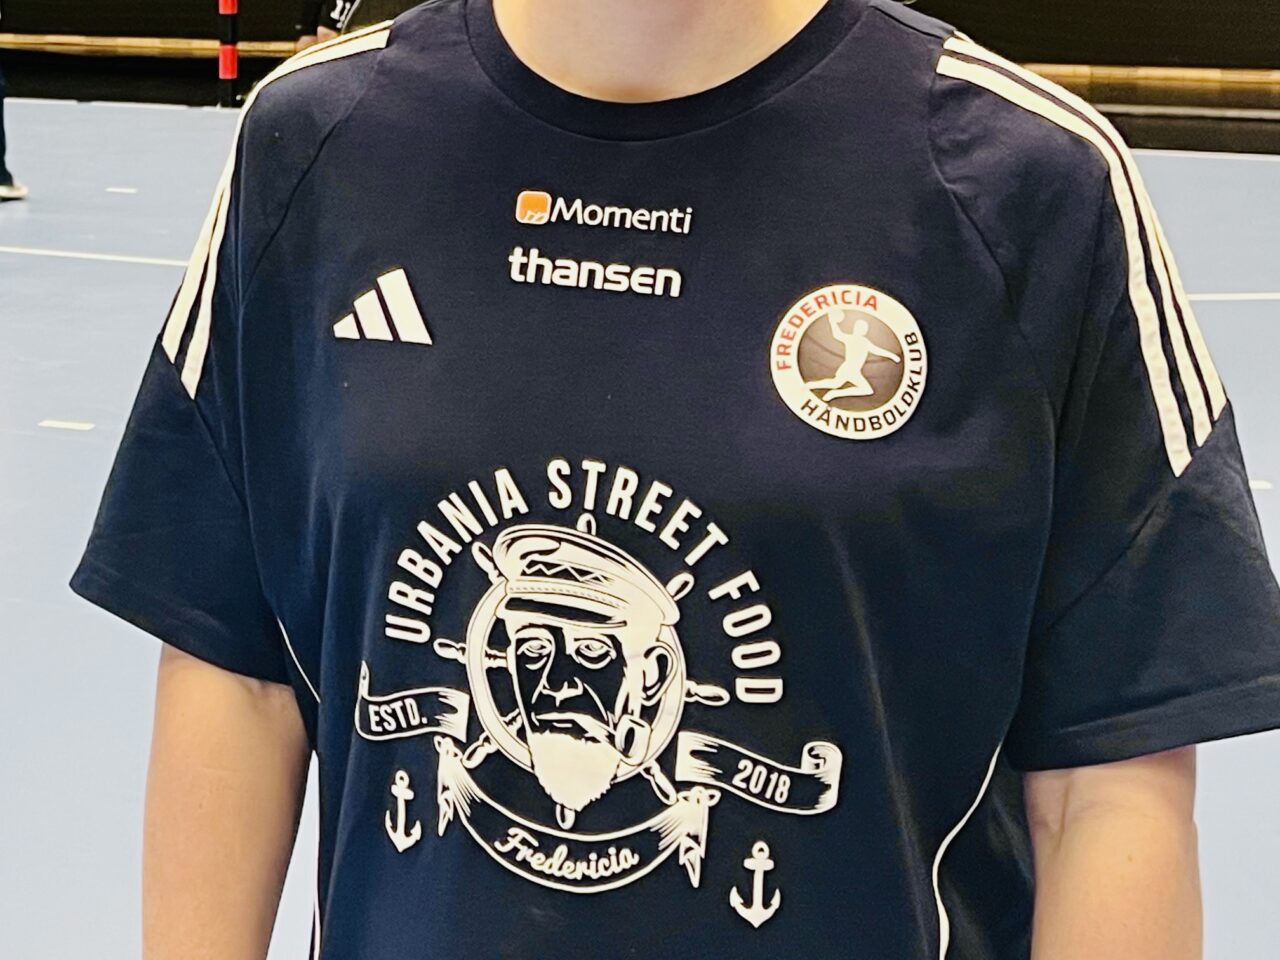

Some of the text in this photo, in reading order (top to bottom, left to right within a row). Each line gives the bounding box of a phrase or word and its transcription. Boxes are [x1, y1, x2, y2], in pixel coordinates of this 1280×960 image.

[550, 197, 693, 234] Momenti
[508, 246, 682, 298] thansen
[776, 290, 878, 372] FREDERICIA
[385, 457, 784, 705] URBANIA STREET FOOD
[368, 705, 428, 734] ESTD.
[731, 759, 791, 805] 2018
[493, 827, 640, 880] Fredericia
